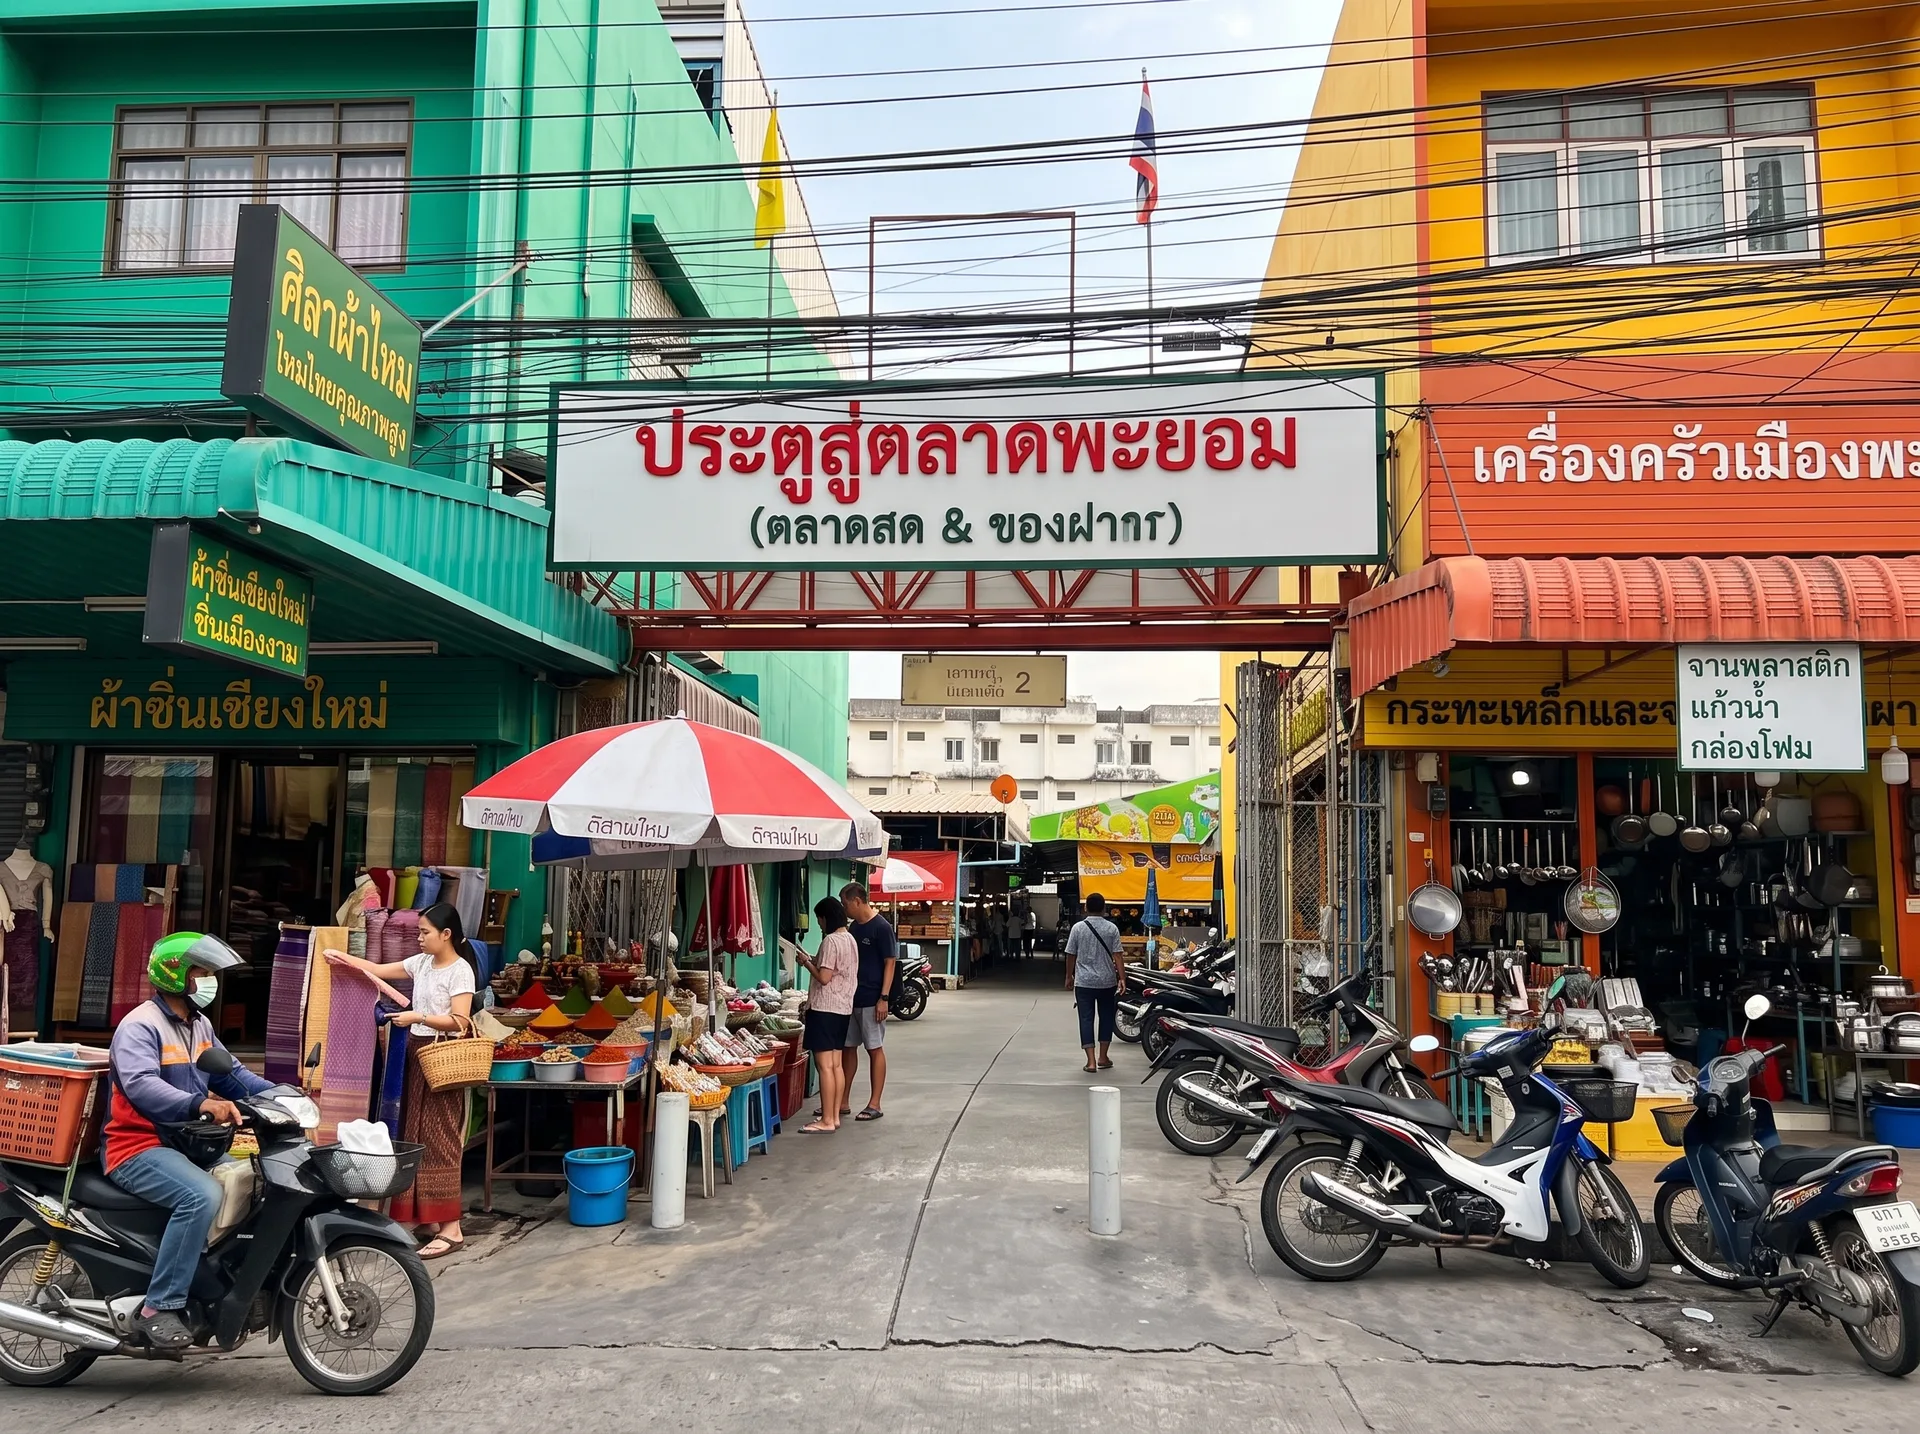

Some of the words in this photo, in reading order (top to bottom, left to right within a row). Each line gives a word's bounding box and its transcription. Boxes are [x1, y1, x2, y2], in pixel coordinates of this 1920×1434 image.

[281, 248, 412, 404] ศิลาผ้าไหม
[276, 330, 407, 458] ไหมไทยคุณภาพสูง
[636, 401, 1297, 504] ประตูสู่ตลาดพะยอม
[751, 506, 924, 548] (ตลาดสด
[941, 507, 973, 545] &
[1015, 671, 1031, 694] 2
[1688, 648, 1850, 677] จานพลาสติก
[1691, 680, 1779, 719] แก้วน้ำ
[1691, 728, 1812, 760] กล่องโฟม
